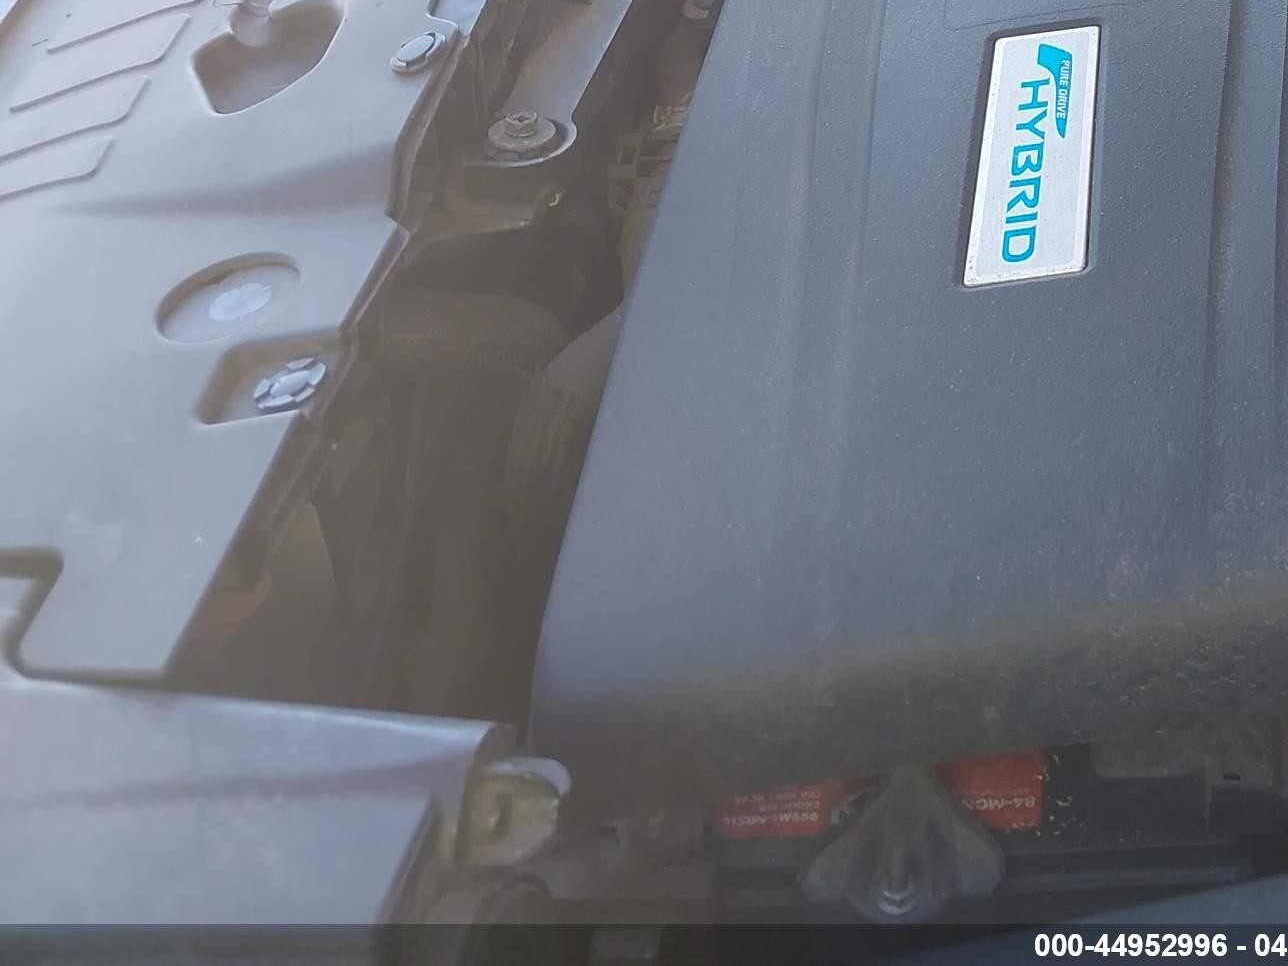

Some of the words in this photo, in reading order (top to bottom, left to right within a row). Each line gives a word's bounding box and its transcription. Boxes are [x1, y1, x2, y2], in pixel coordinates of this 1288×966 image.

[1059, 59, 1071, 86] PURE
[1056, 88, 1068, 120] DRIVE
[1001, 77, 1050, 263] HYBRID
